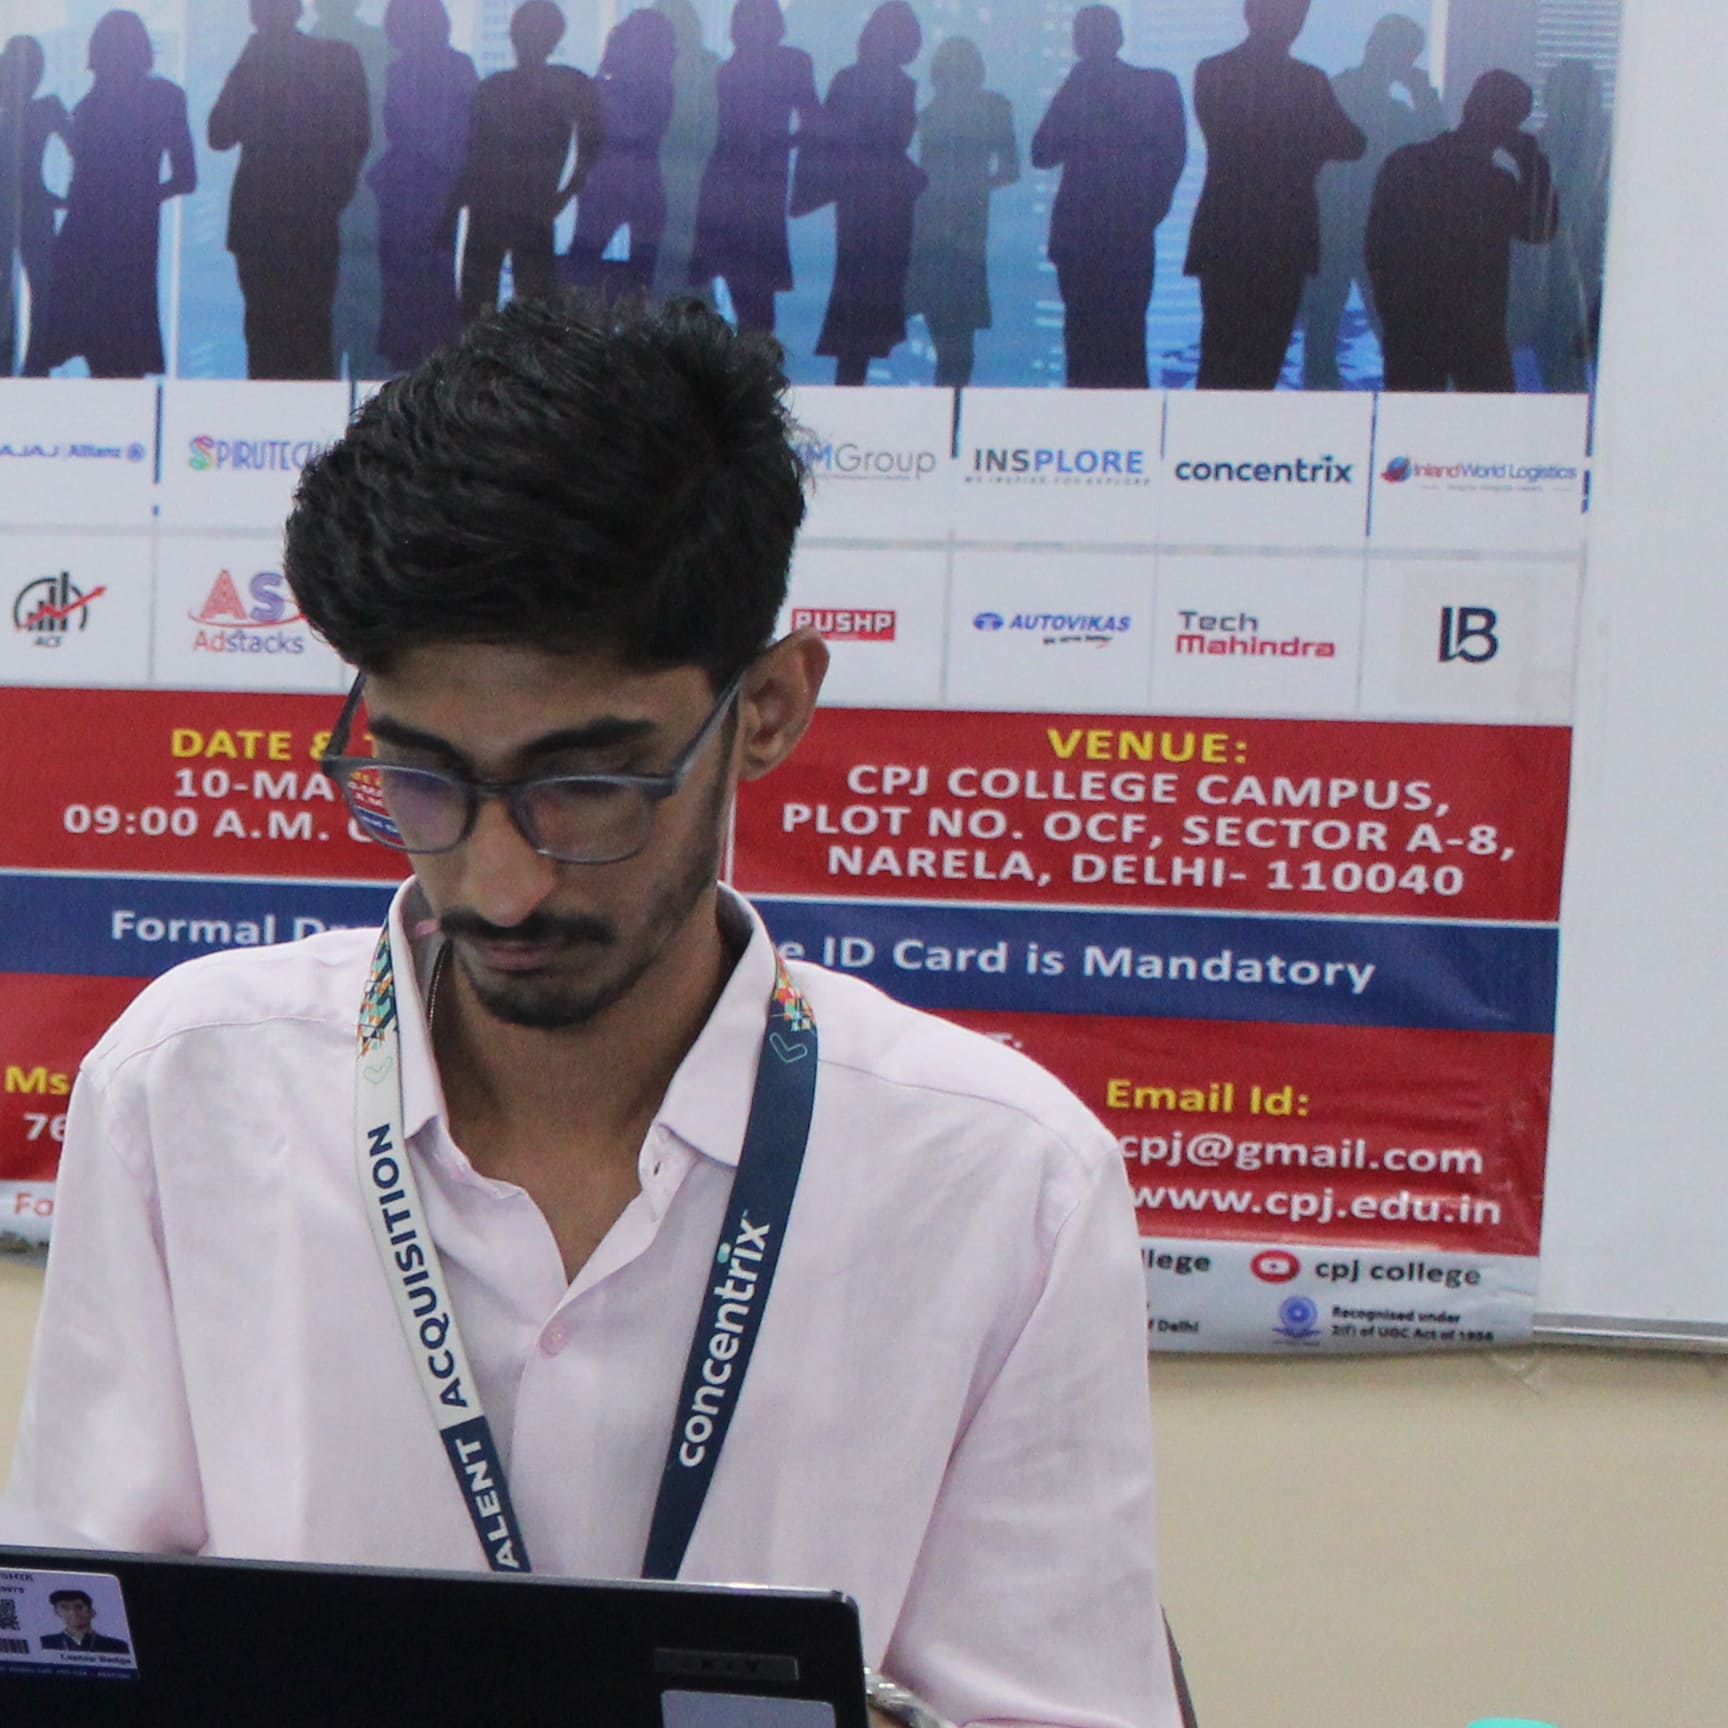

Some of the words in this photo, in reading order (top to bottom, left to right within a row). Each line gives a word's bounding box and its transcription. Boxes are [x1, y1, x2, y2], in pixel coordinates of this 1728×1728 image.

[67, 443, 122, 459] Allianz
[974, 448, 1145, 475] INSPLORE
[1175, 453, 1354, 484] concentrix
[1009, 613, 1131, 633] AUTOVIKAS
[1177, 610, 1259, 632] Tech
[193, 629, 305, 655] Adstacks
[1175, 634, 1336, 658] Mahindra
[171, 728, 293, 761] DATE
[1046, 728, 1248, 765] VENUE:
[847, 765, 930, 797] CPJ
[947, 768, 1179, 804] COLLEGE
[1196, 773, 1450, 817] CAMPUS,
[63, 804, 199, 836] 09:00
[213, 810, 330, 841] A.M.
[782, 803, 911, 836] PLOT
[928, 808, 1024, 840] NO.
[1043, 811, 1163, 849] OCF,
[1182, 816, 1388, 852] SECTOR
[1405, 824, 1516, 862] A-8,
[827, 845, 1052, 887] NARELA,
[1072, 853, 1247, 888] DELHI-
[1266, 860, 1464, 897] 110040
[111, 909, 275, 945] Formal
[823, 936, 875, 969] ID
[893, 938, 1009, 974] Card
[1026, 943, 1065, 976] is
[1084, 945, 1377, 995] Mandatory
[1106, 1078, 1234, 1114] Email
[1250, 1085, 1310, 1117] Id:
[1118, 1132, 1484, 1175] cpj@gmail.com
[1134, 1186, 1501, 1226] www.cpj.edu.in
[367, 1122, 469, 1409] ACQUISITION
[1370, 1261, 1482, 1289] college
[678, 1220, 772, 1468] concentrix
[455, 1438, 522, 1571] ALENT
